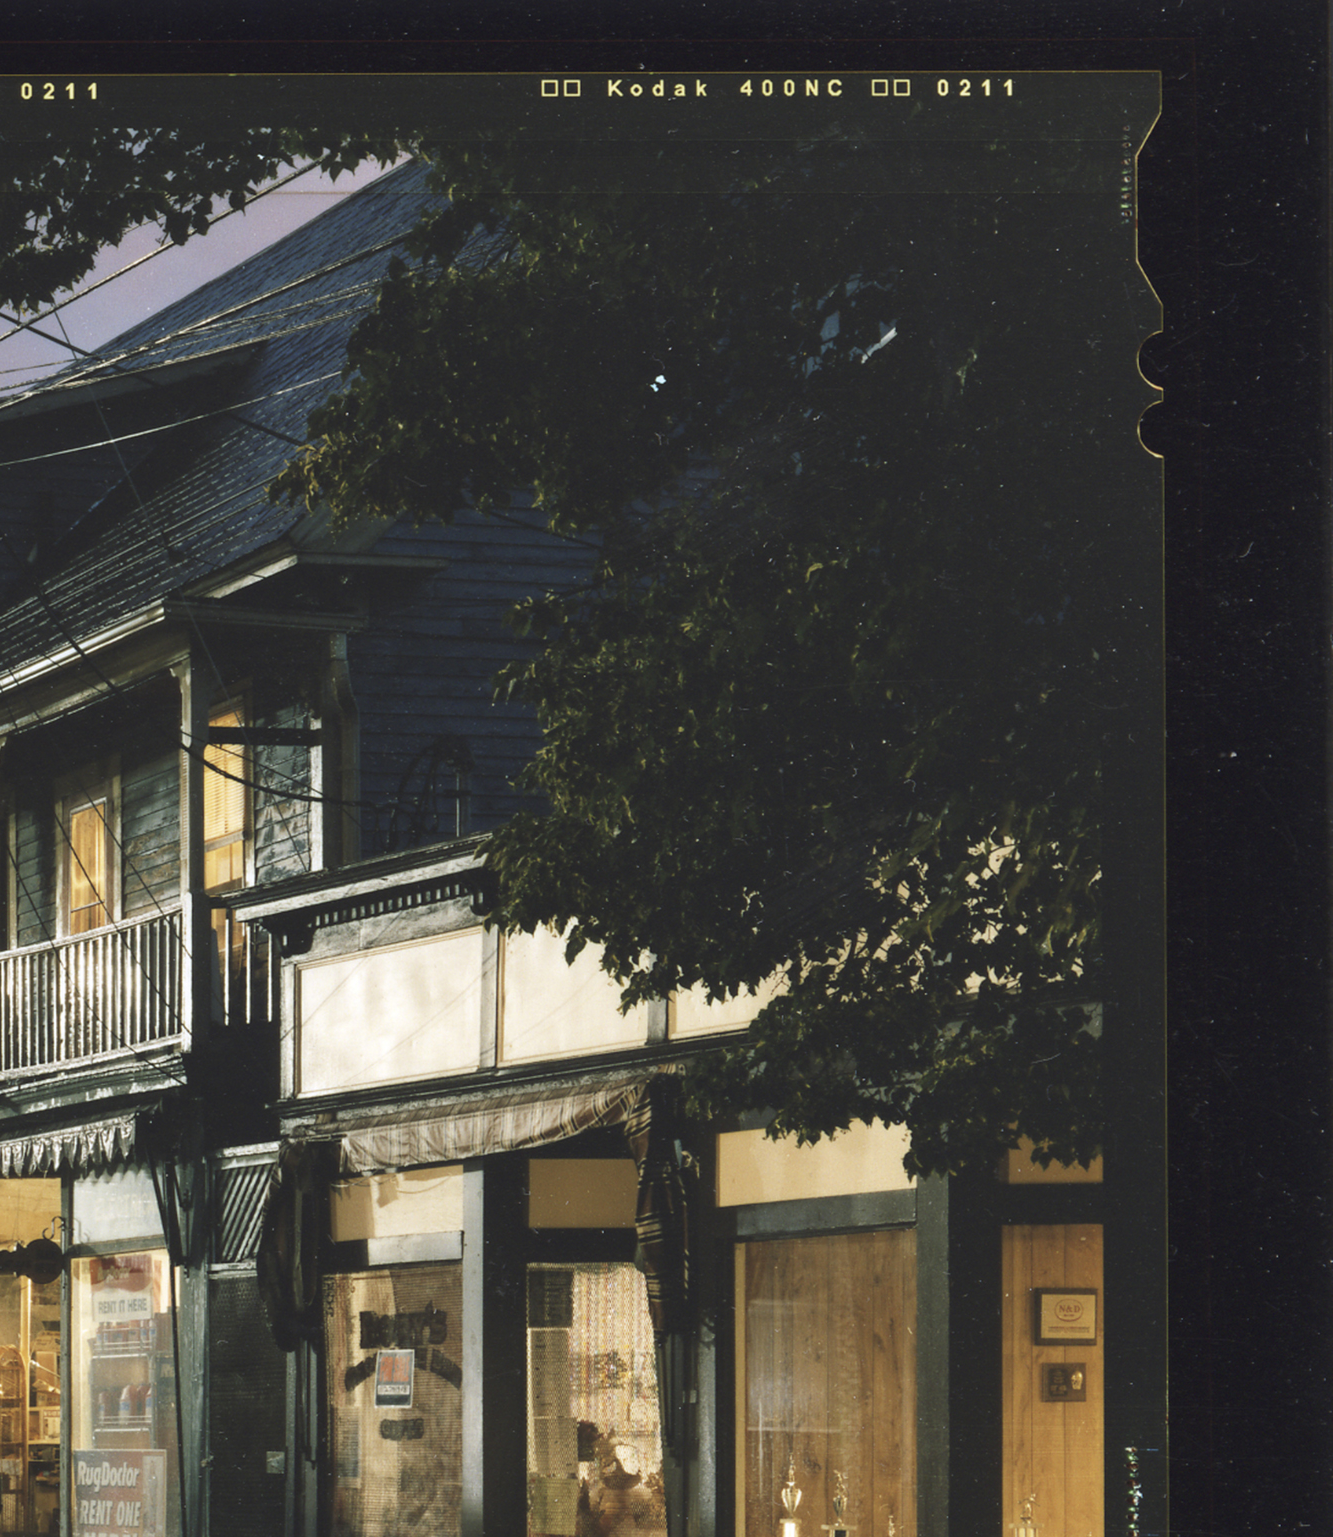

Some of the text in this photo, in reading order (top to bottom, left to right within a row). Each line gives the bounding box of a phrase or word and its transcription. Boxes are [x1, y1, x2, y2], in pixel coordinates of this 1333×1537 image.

[128, 1298, 148, 1312] HERE
[79, 1500, 142, 1527] RENT ONE
